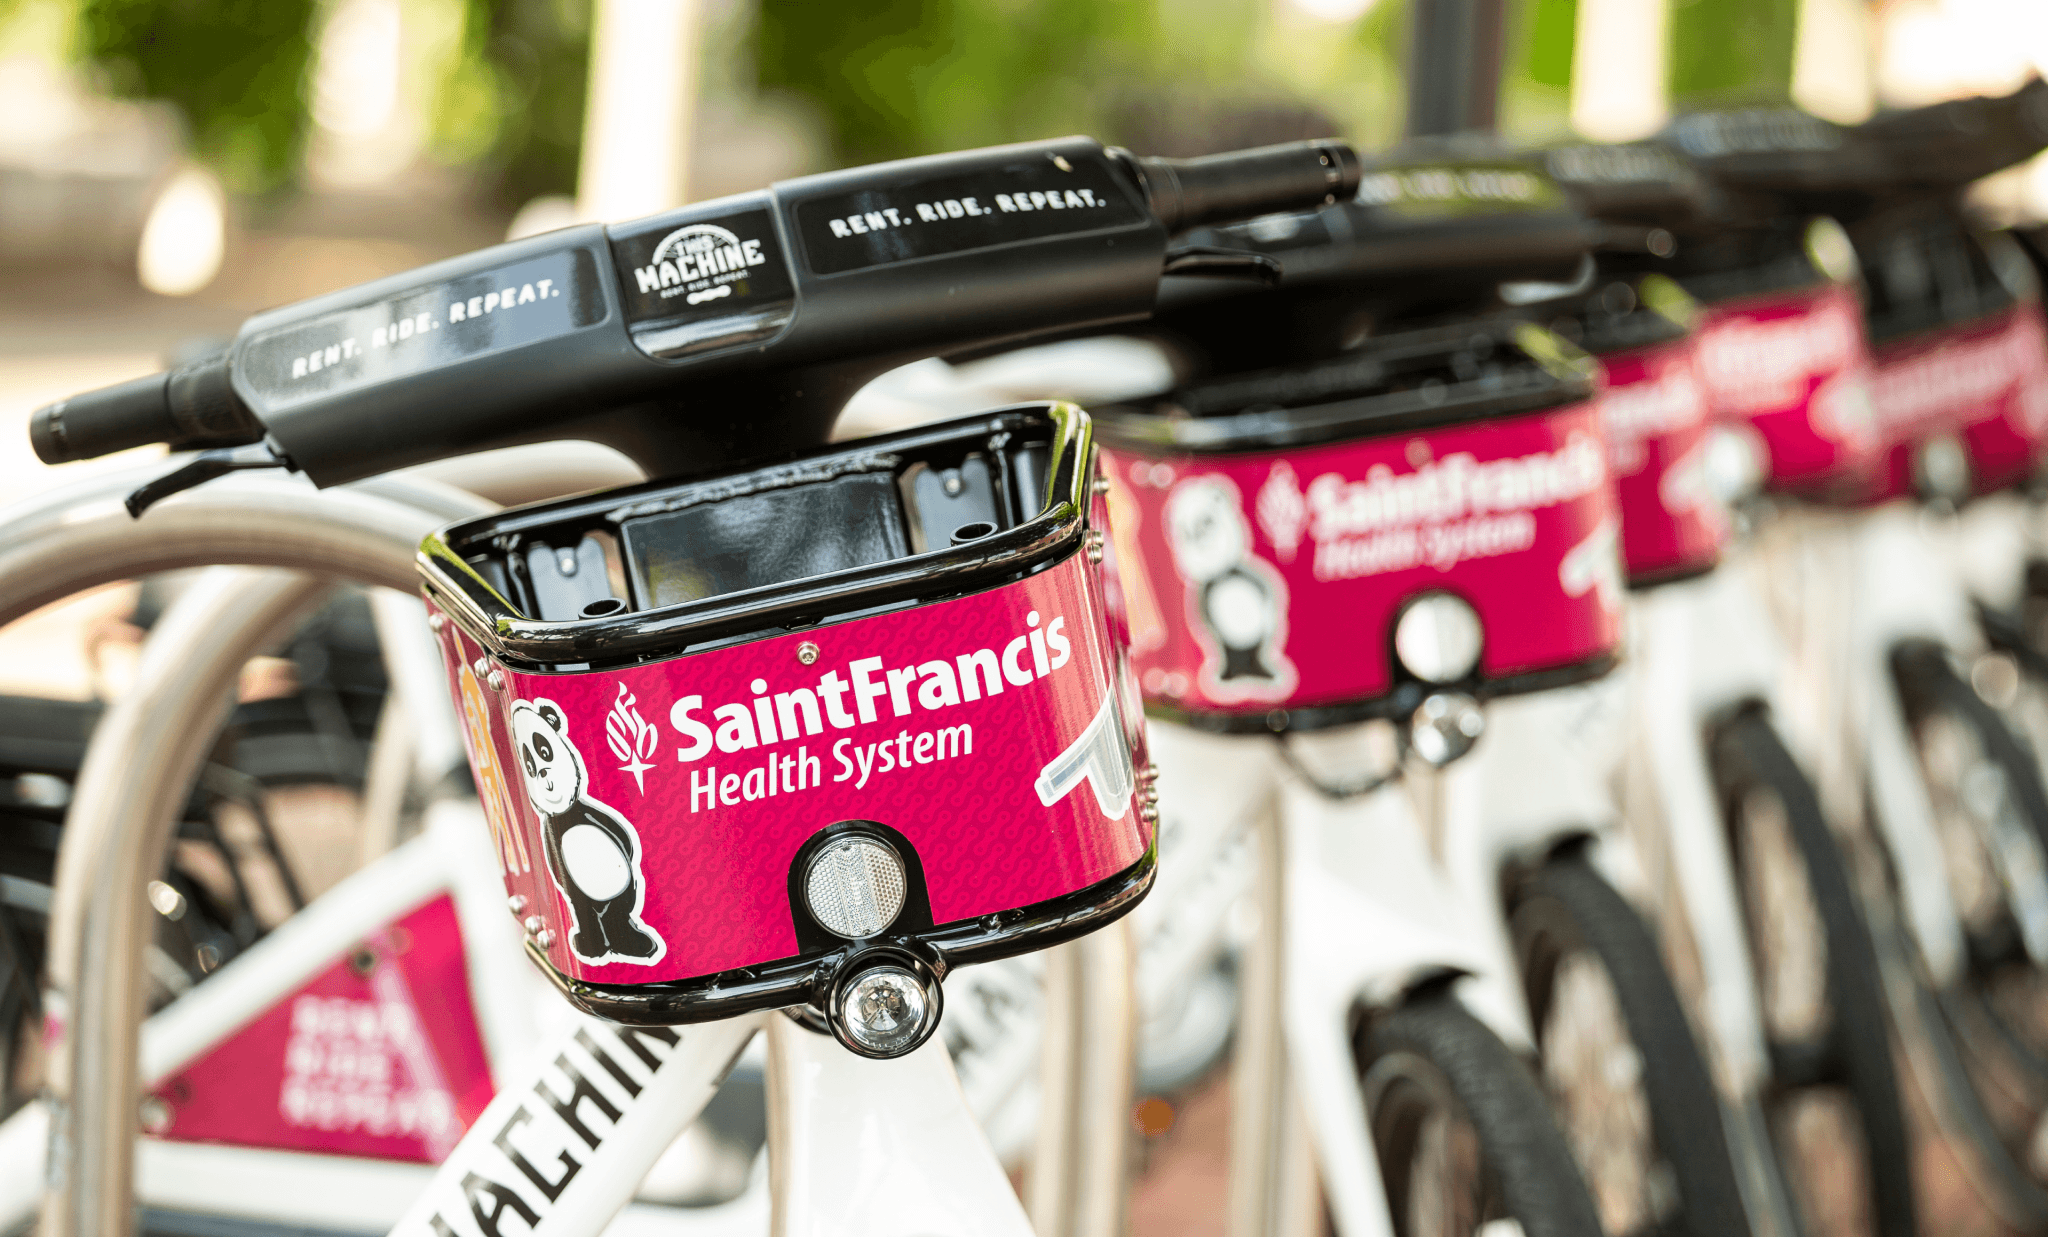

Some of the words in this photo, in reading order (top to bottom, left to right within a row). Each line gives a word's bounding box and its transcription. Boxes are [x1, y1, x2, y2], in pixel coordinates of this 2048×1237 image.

[829, 207, 912, 239] RENT.
[915, 196, 992, 222] RIDE.
[994, 188, 1106, 213] REPEAT.
[633, 238, 766, 294] MACHINE
[292, 337, 362, 380] RENT.
[372, 311, 439, 349] RIDE.
[449, 278, 560, 324] REPEAT.
[690, 745, 821, 813] Health
[833, 722, 973, 790] System
